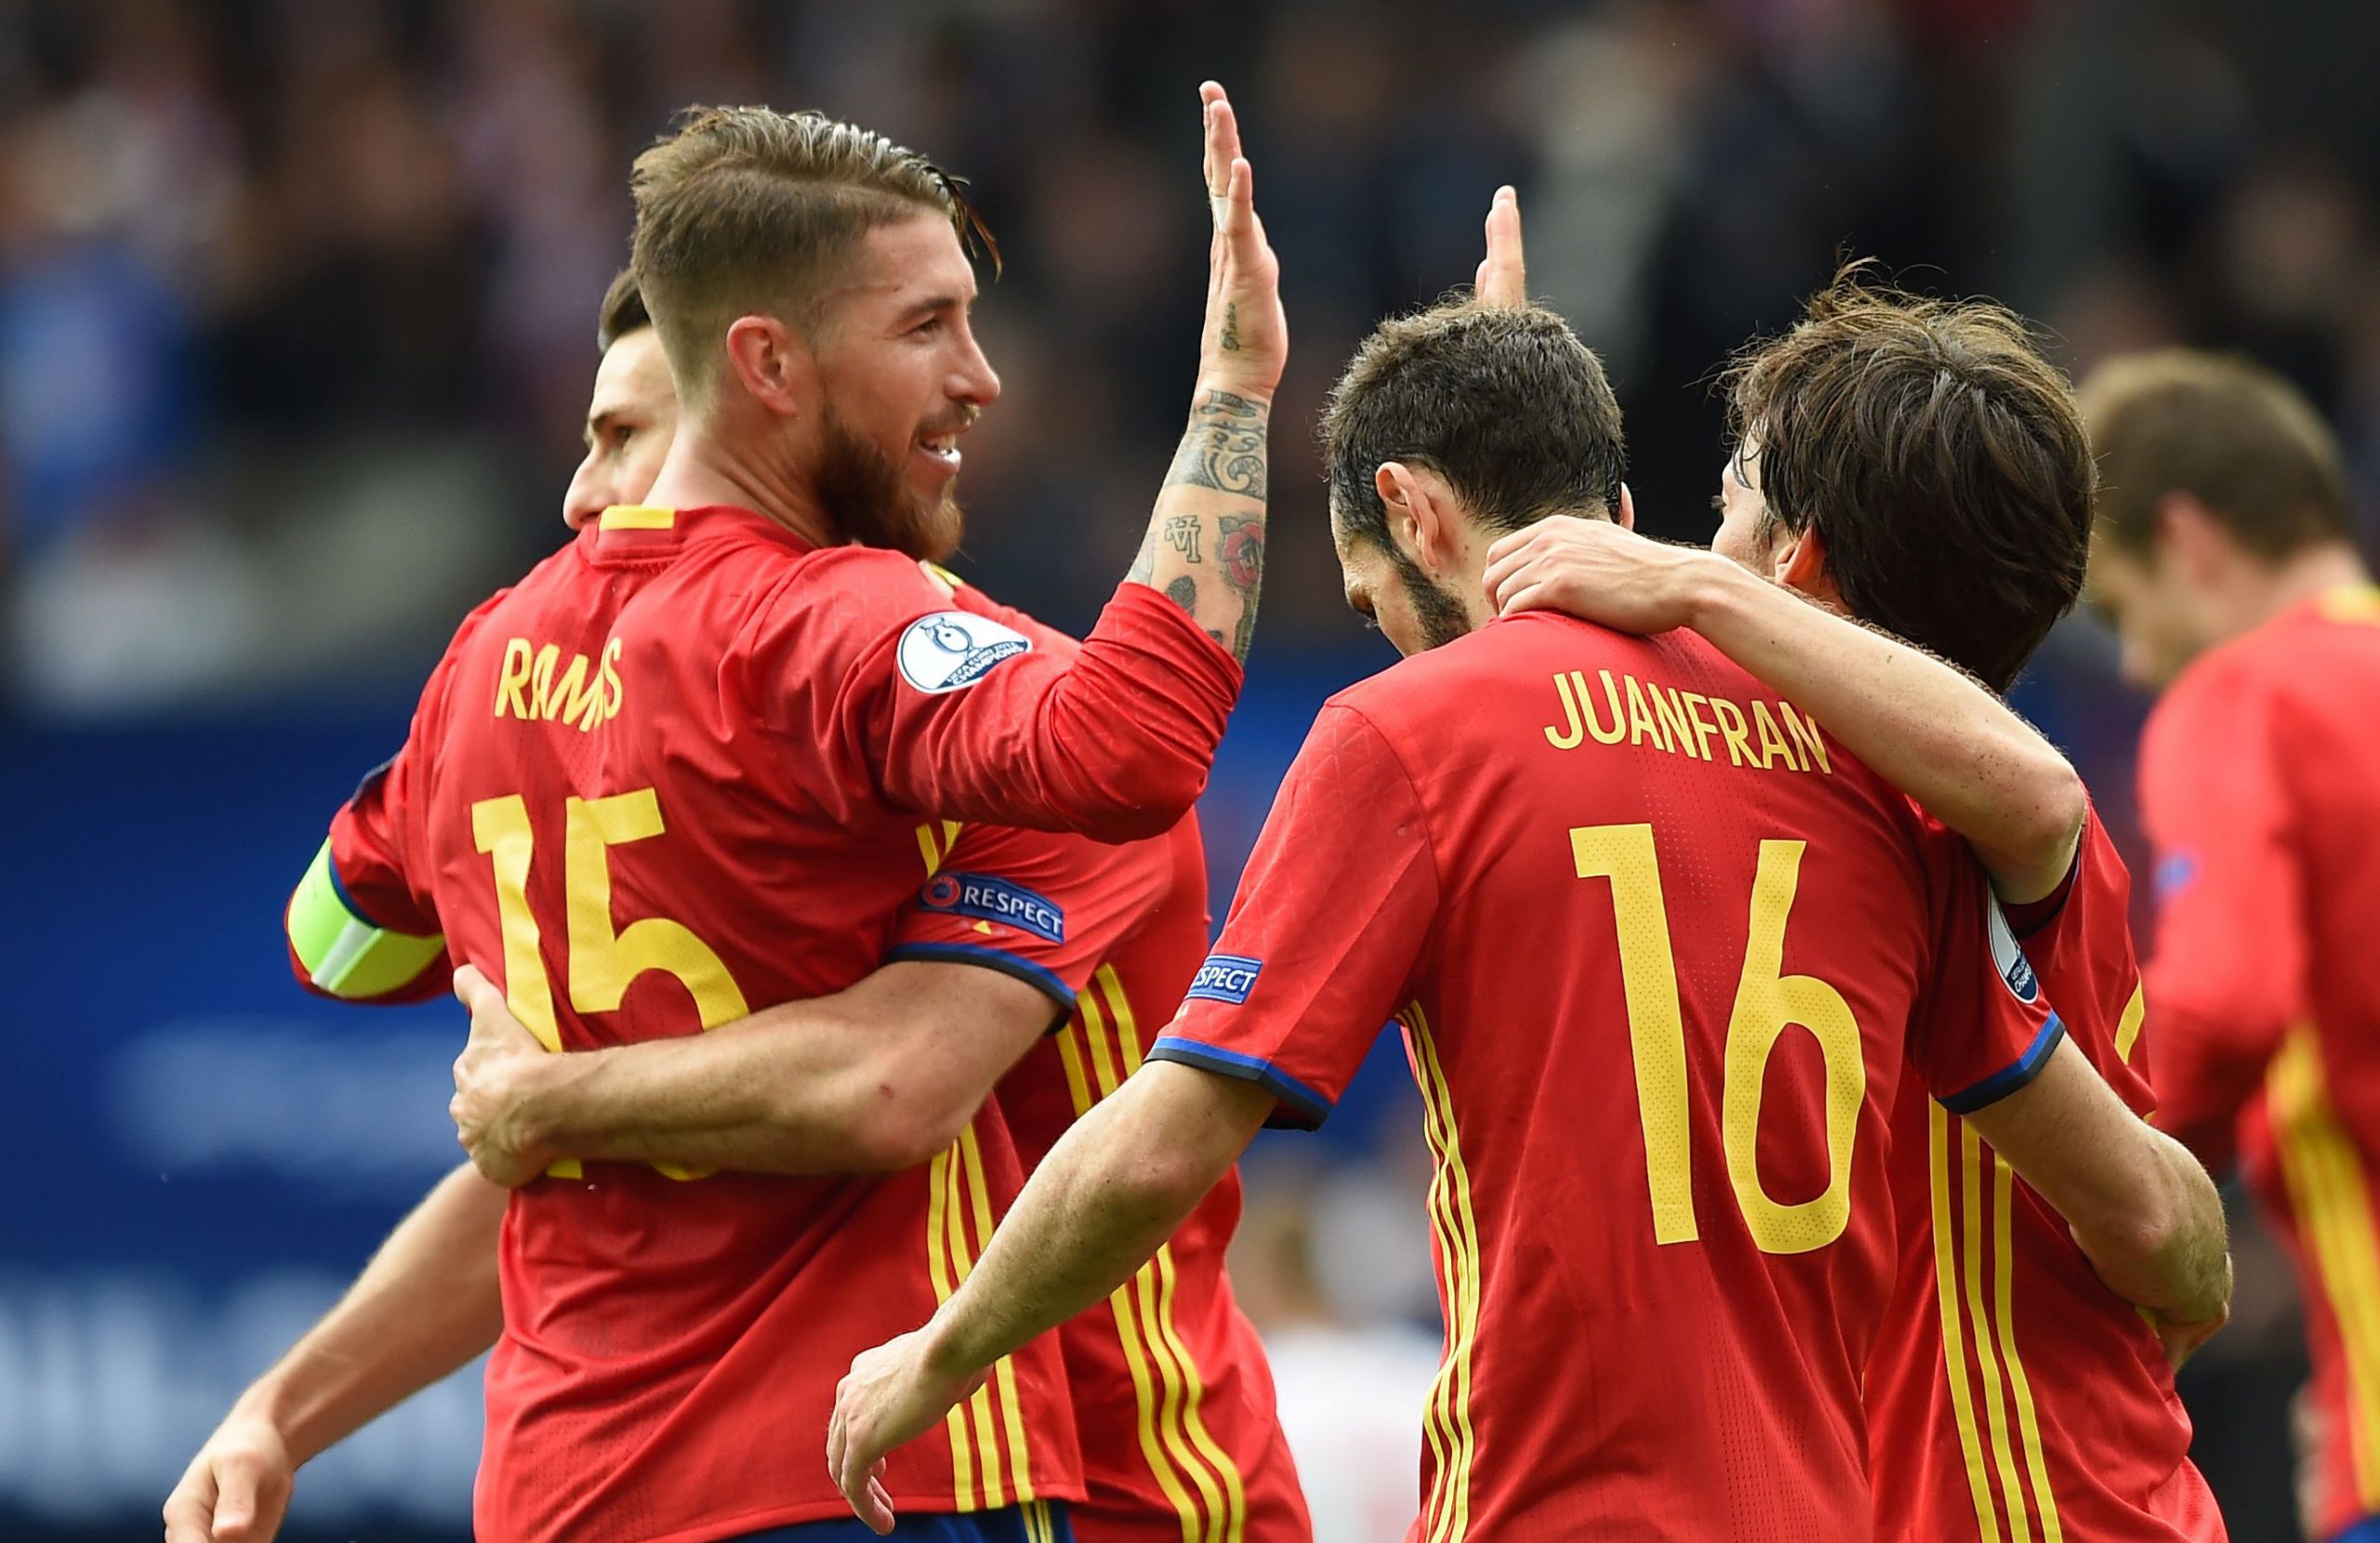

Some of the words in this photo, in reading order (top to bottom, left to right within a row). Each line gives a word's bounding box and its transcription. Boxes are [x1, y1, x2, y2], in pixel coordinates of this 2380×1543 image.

[494, 637, 622, 732] RAMS
[1544, 668, 1832, 774] JUANFRAN
[964, 886, 1063, 935] RESPECT
[471, 788, 750, 1179] 15
[1191, 966, 1257, 992] SPECT
[1568, 823, 1867, 1254] 16
